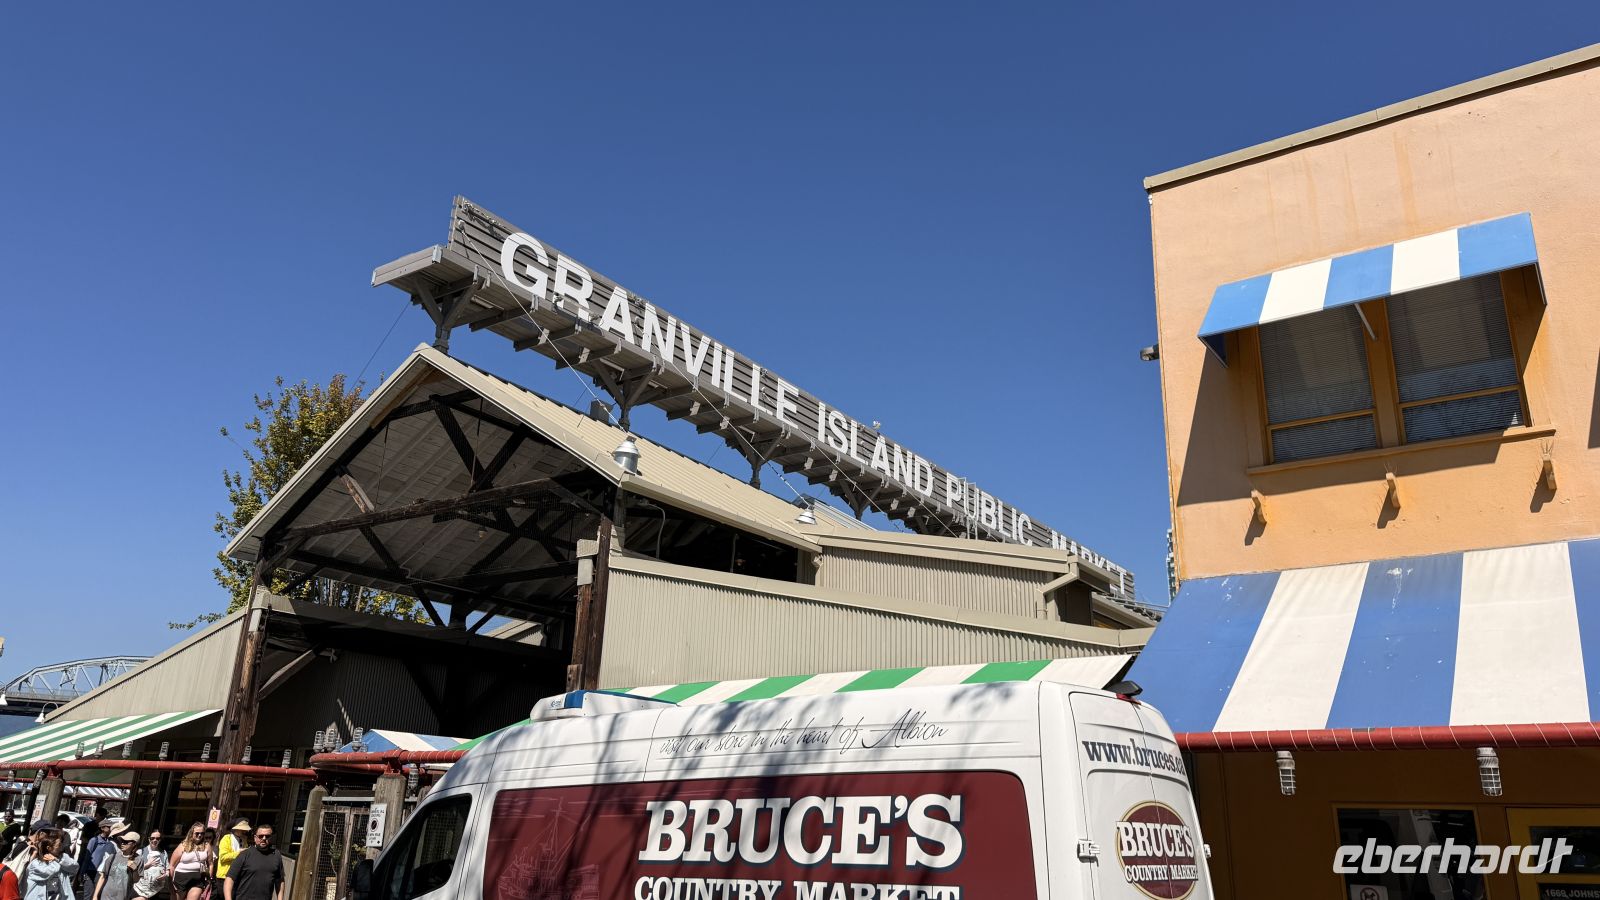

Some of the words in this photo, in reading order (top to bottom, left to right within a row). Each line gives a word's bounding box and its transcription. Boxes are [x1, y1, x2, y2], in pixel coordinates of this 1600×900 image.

[500, 232, 799, 429] GRANVILLE
[817, 402, 934, 498] ISLAND
[946, 472, 1033, 546] PUBLIC
[660, 728, 692, 754] visit
[687, 737, 710, 752] our
[715, 724, 746, 752] store
[751, 730, 772, 749] in
[769, 718, 793, 748] the
[797, 717, 842, 746] heart
[840, 716, 865, 755] of
[861, 708, 949, 749] Albion
[638, 793, 964, 869] BRUCE'S
[1116, 821, 1195, 858] BRUCE'S
[1125, 864, 1168, 882] COUNTRY
